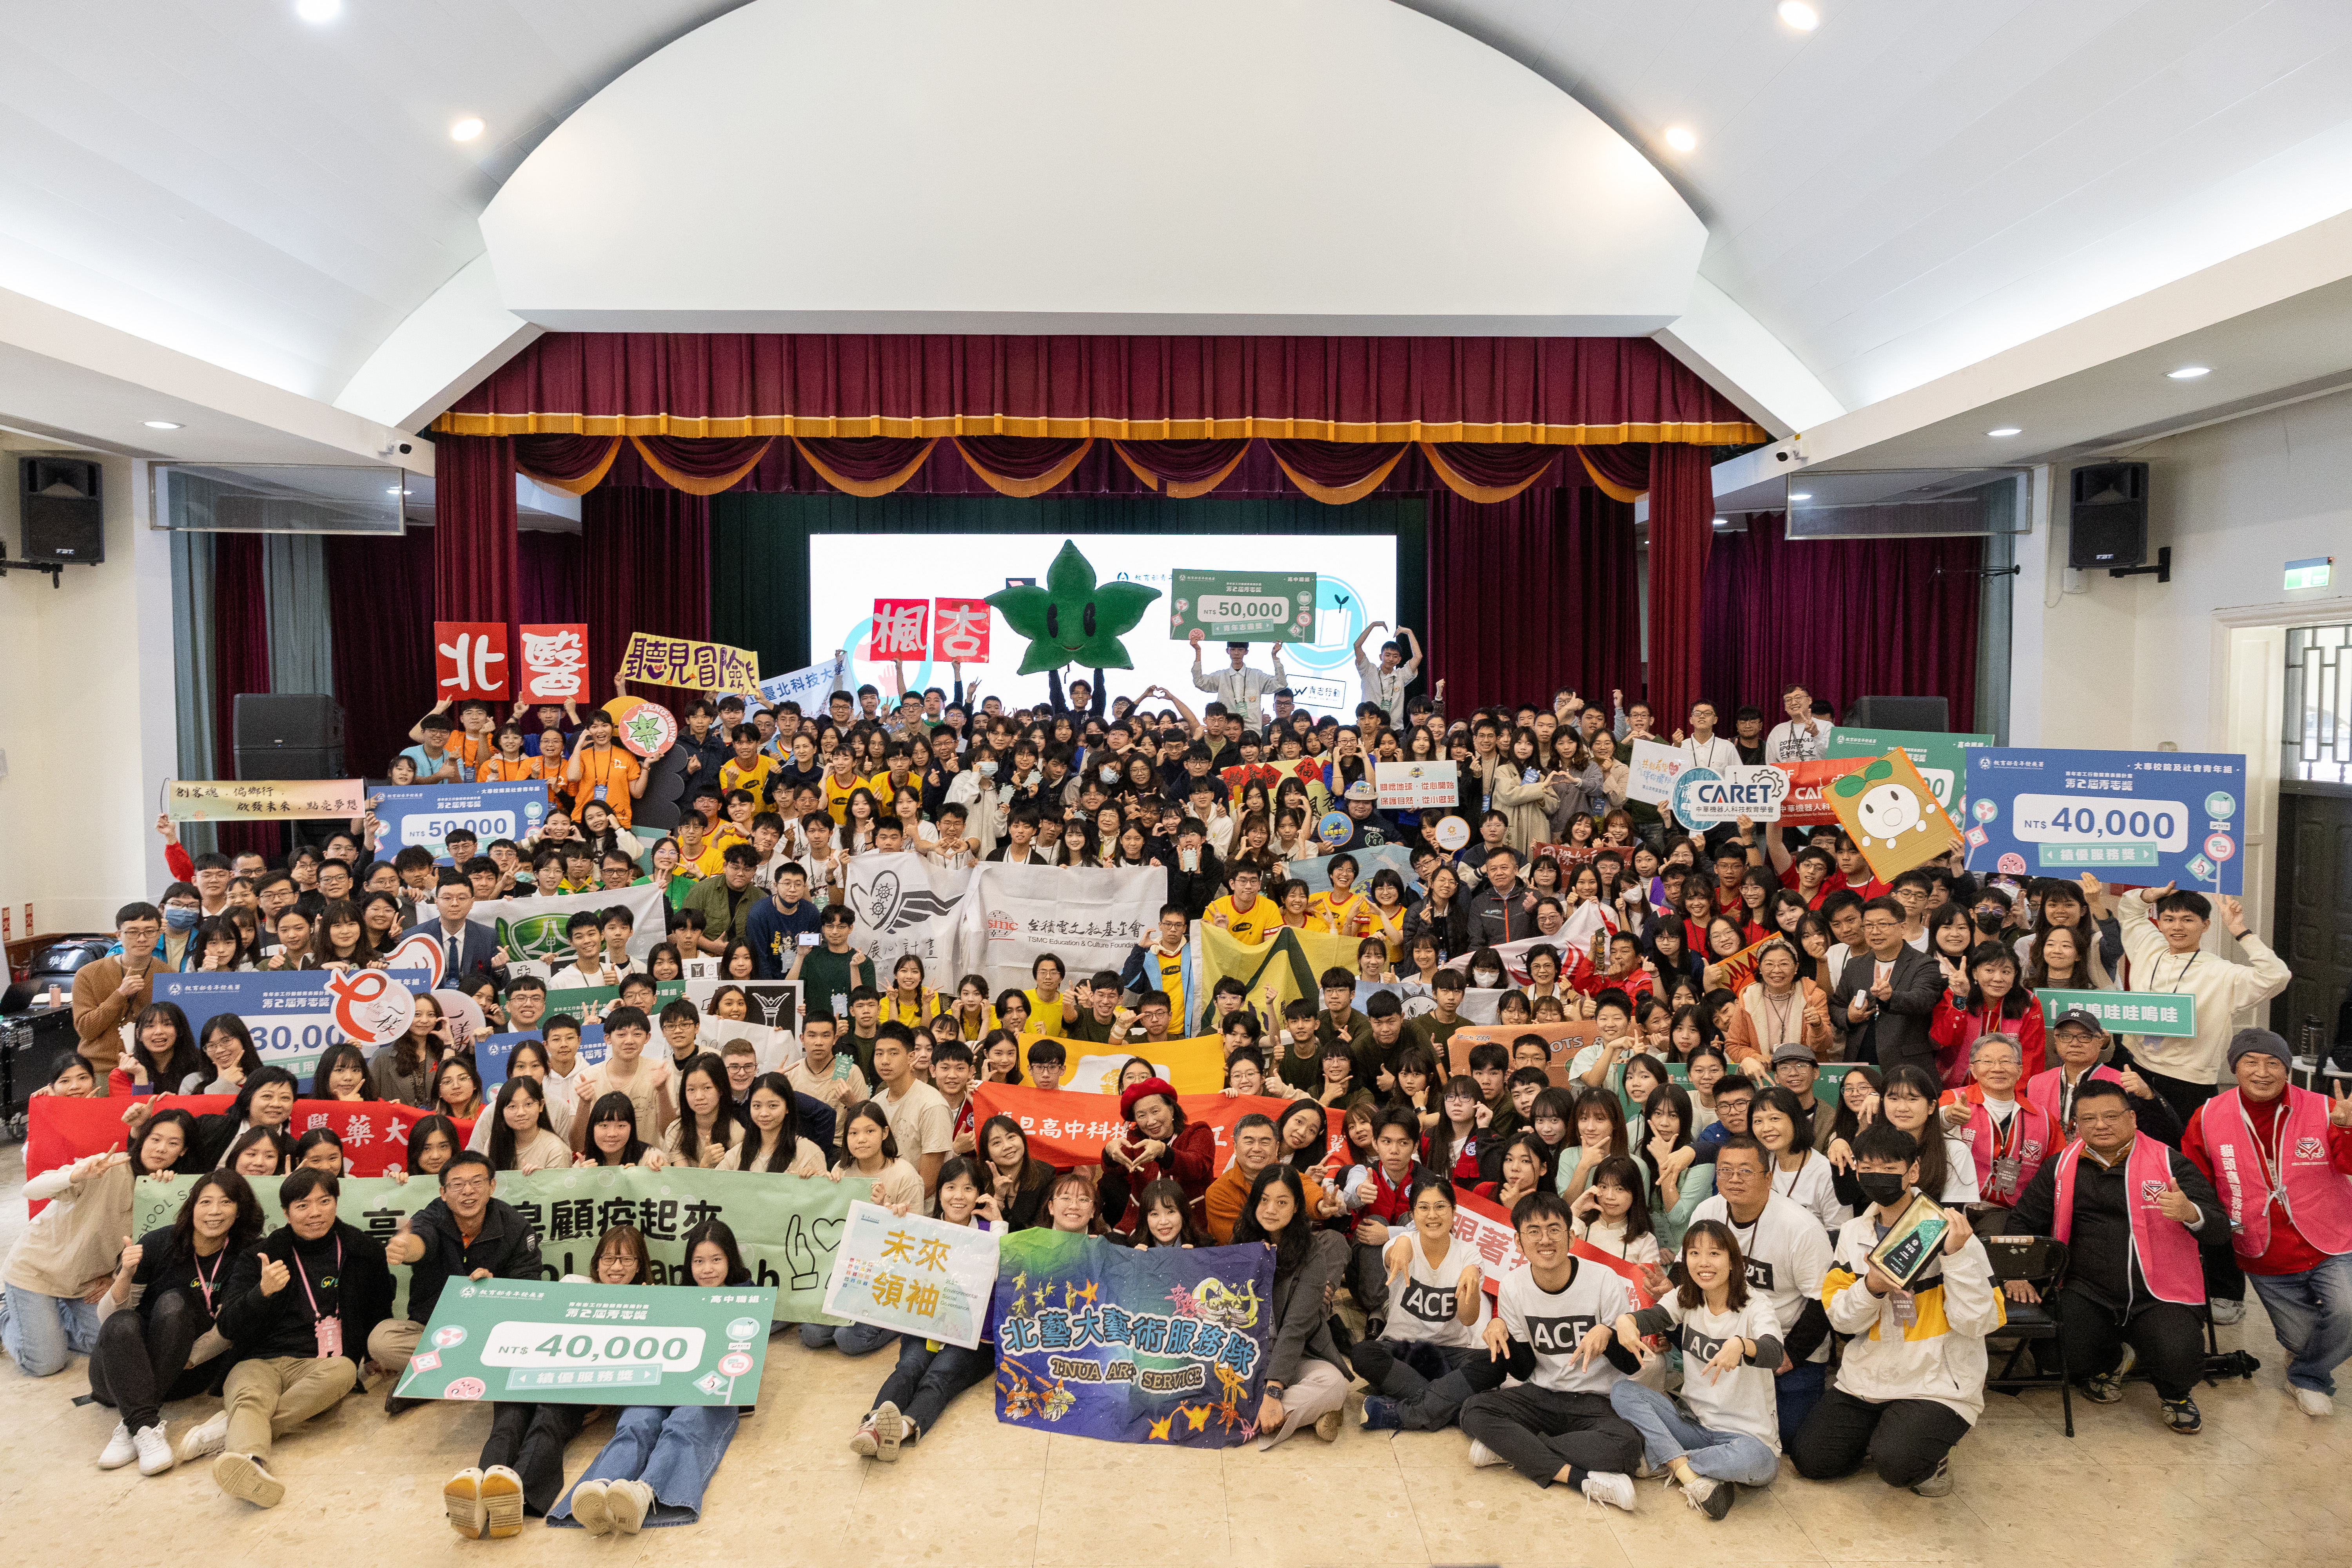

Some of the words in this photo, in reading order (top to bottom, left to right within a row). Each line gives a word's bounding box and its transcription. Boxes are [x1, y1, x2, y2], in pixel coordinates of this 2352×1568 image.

[1219, 602, 1282, 618] 50,000
[872, 604, 926, 652] 楓
[936, 605, 987, 657] 杏
[439, 633, 505, 691] 北
[521, 631, 586, 697] 醫
[2134, 762, 2232, 773] 大專校院及社會青年組
[1699, 784, 1771, 803] CARET
[430, 818, 506, 837] 50000
[2025, 820, 2047, 829] NT$
[2051, 808, 2174, 839] 40,000
[988, 920, 1018, 931] smc
[1028, 919, 1145, 938] 台積電文教基金會
[881, 1230, 951, 1272] 未來
[479, 1289, 544, 1298] 教育部青年發展署
[710, 1295, 760, 1303] 高中職組
[871, 1271, 940, 1318] 領袖
[942, 1294, 958, 1302] Social
[943, 1287, 978, 1300] Environmental
[1407, 1287, 1455, 1317] ACE
[565, 1308, 647, 1320] 第2屆青志獎
[940, 1300, 970, 1312] Governance
[498, 1346, 528, 1355] NT$
[535, 1334, 688, 1361] 40,000
[1003, 1307, 1256, 1375] 北藝大藝術服務隊
[537, 1370, 634, 1384] 績優服務獎
[1051, 1358, 1102, 1381] TNUA
[1142, 1366, 1203, 1391] SERVICE
